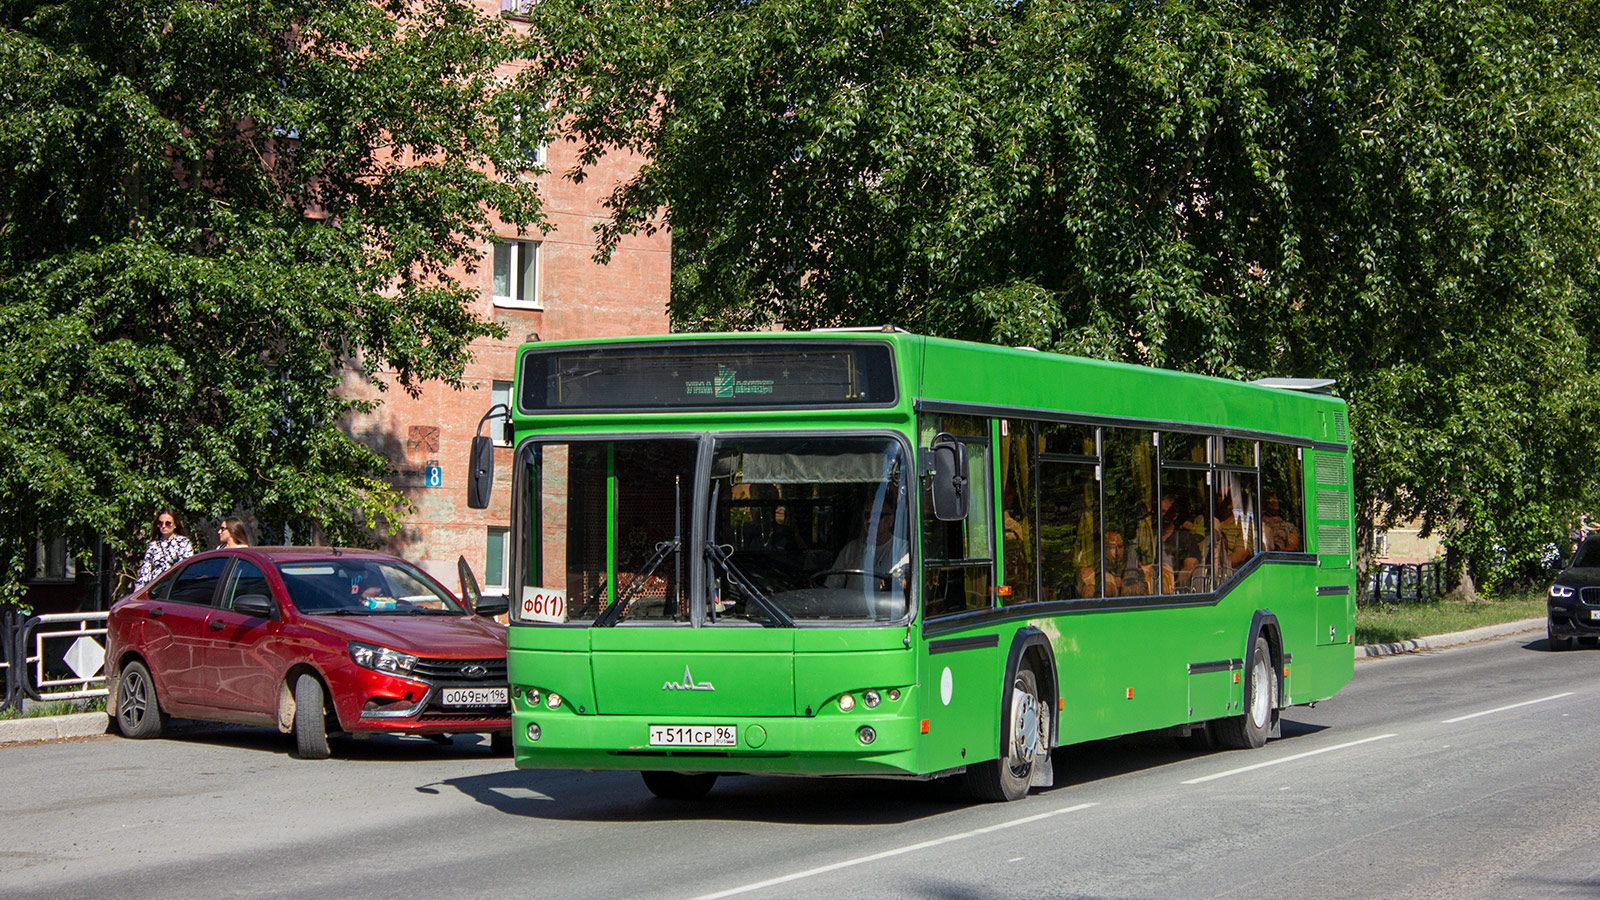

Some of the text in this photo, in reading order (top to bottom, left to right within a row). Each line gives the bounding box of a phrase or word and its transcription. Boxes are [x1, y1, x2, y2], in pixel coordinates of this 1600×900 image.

[430, 467, 440, 486] 8
[490, 689, 505, 699] 196
[716, 727, 731, 739] 96
